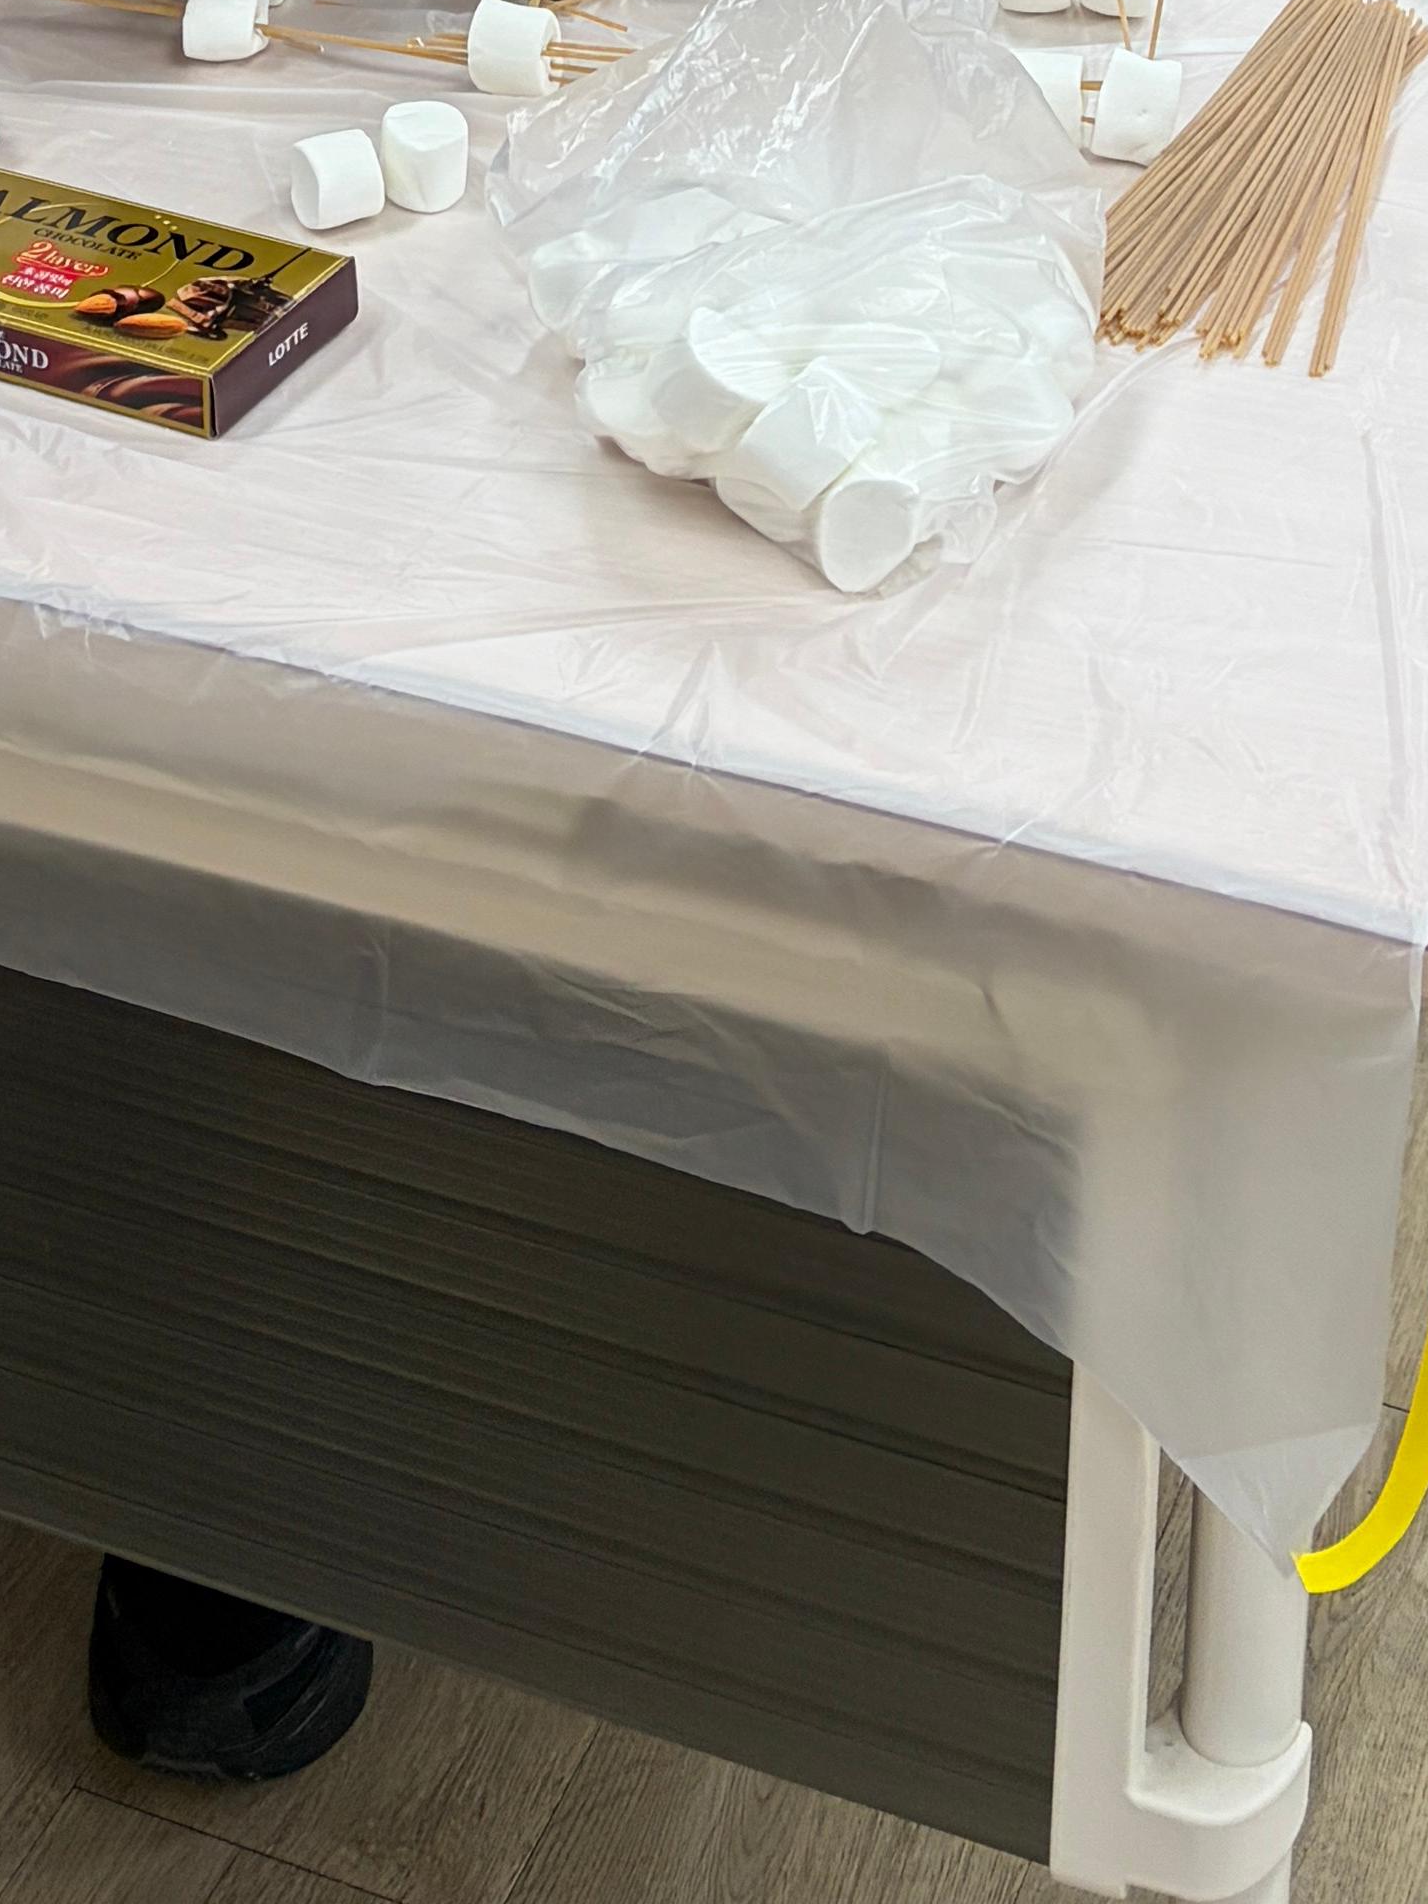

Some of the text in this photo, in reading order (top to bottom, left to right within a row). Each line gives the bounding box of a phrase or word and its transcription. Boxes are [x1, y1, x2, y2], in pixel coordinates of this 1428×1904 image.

[21, 240, 100, 274] 2 layer
[31, 226, 143, 262] CHOCOLATE
[267, 322, 310, 368] LOTTE
